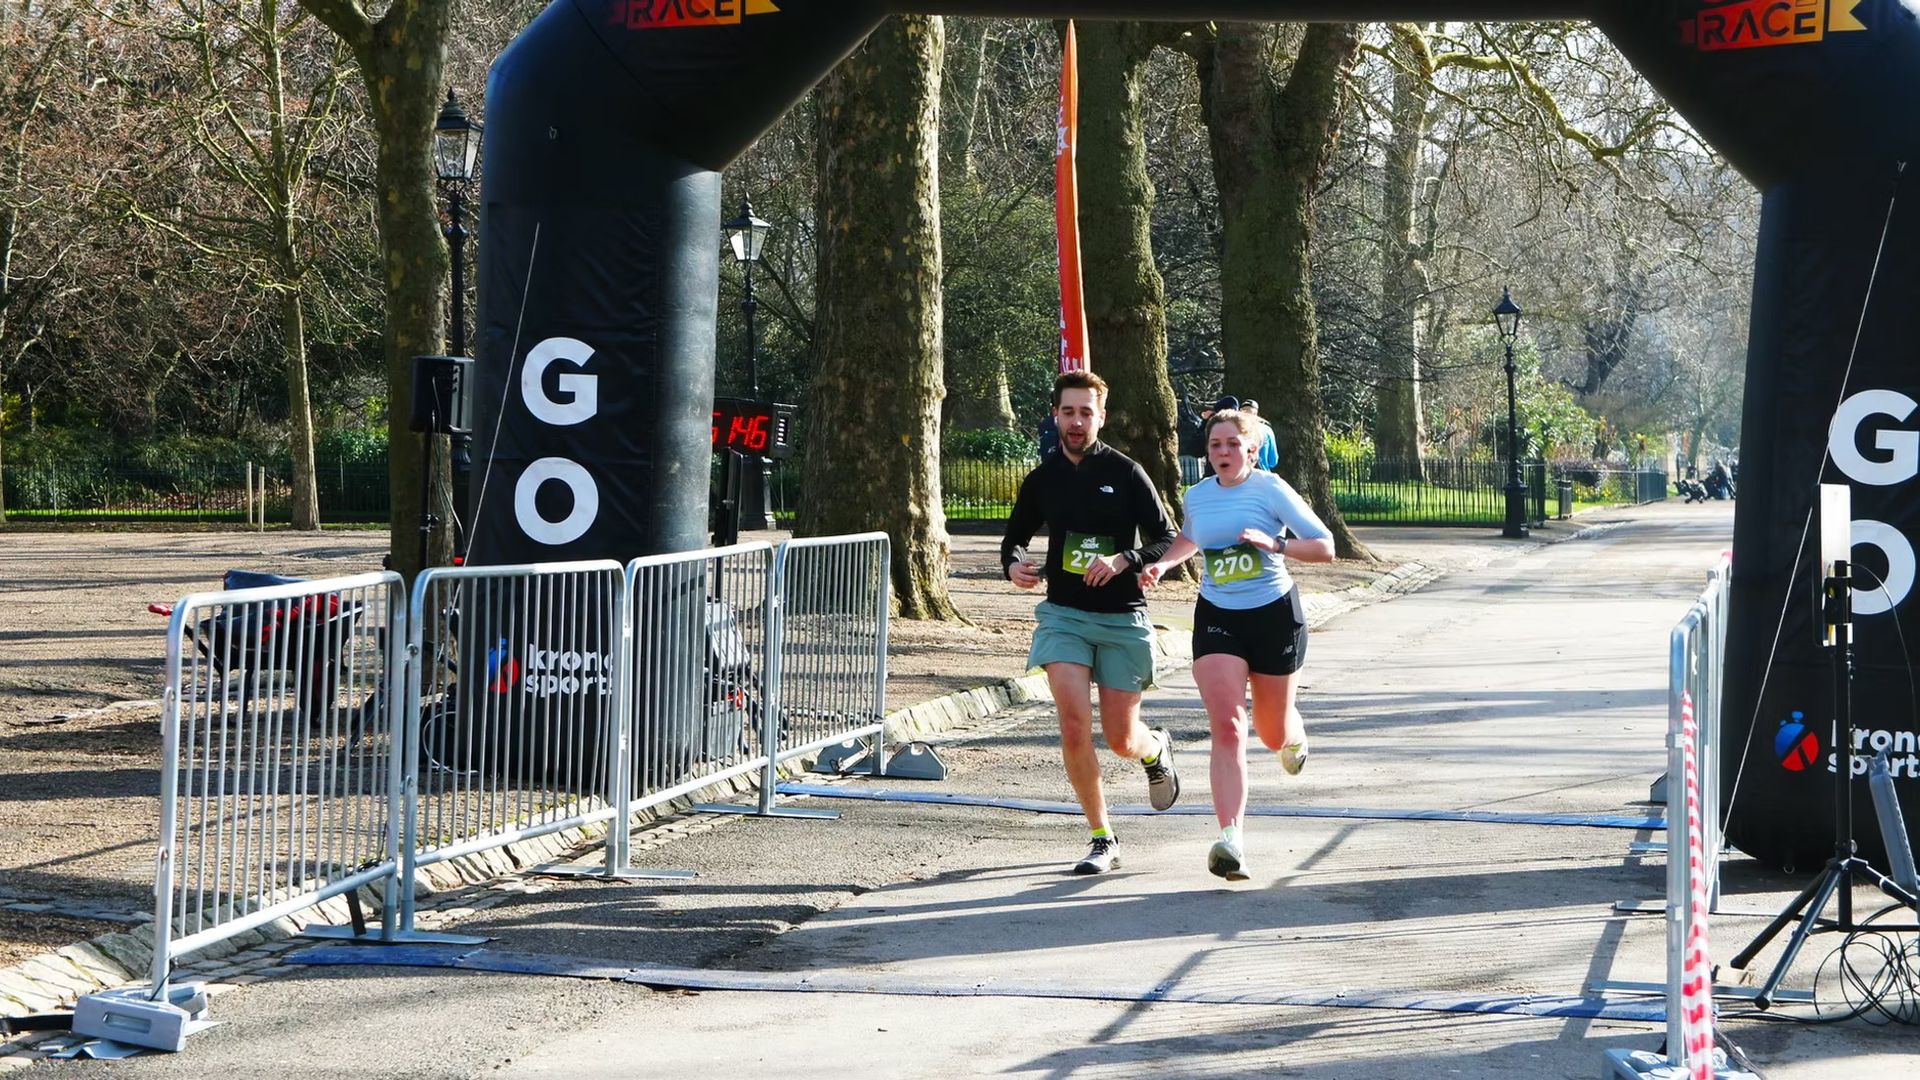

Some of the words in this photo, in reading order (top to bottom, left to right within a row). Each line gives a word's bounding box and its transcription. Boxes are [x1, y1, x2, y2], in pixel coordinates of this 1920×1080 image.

[1703, 1, 1816, 44] RACE
[1070, 550, 1105, 569] 27
[1214, 553, 1254, 577] 270
[525, 673, 613, 698] sport
[1831, 719, 1920, 752] ron
[1827, 753, 1920, 779] sprt
